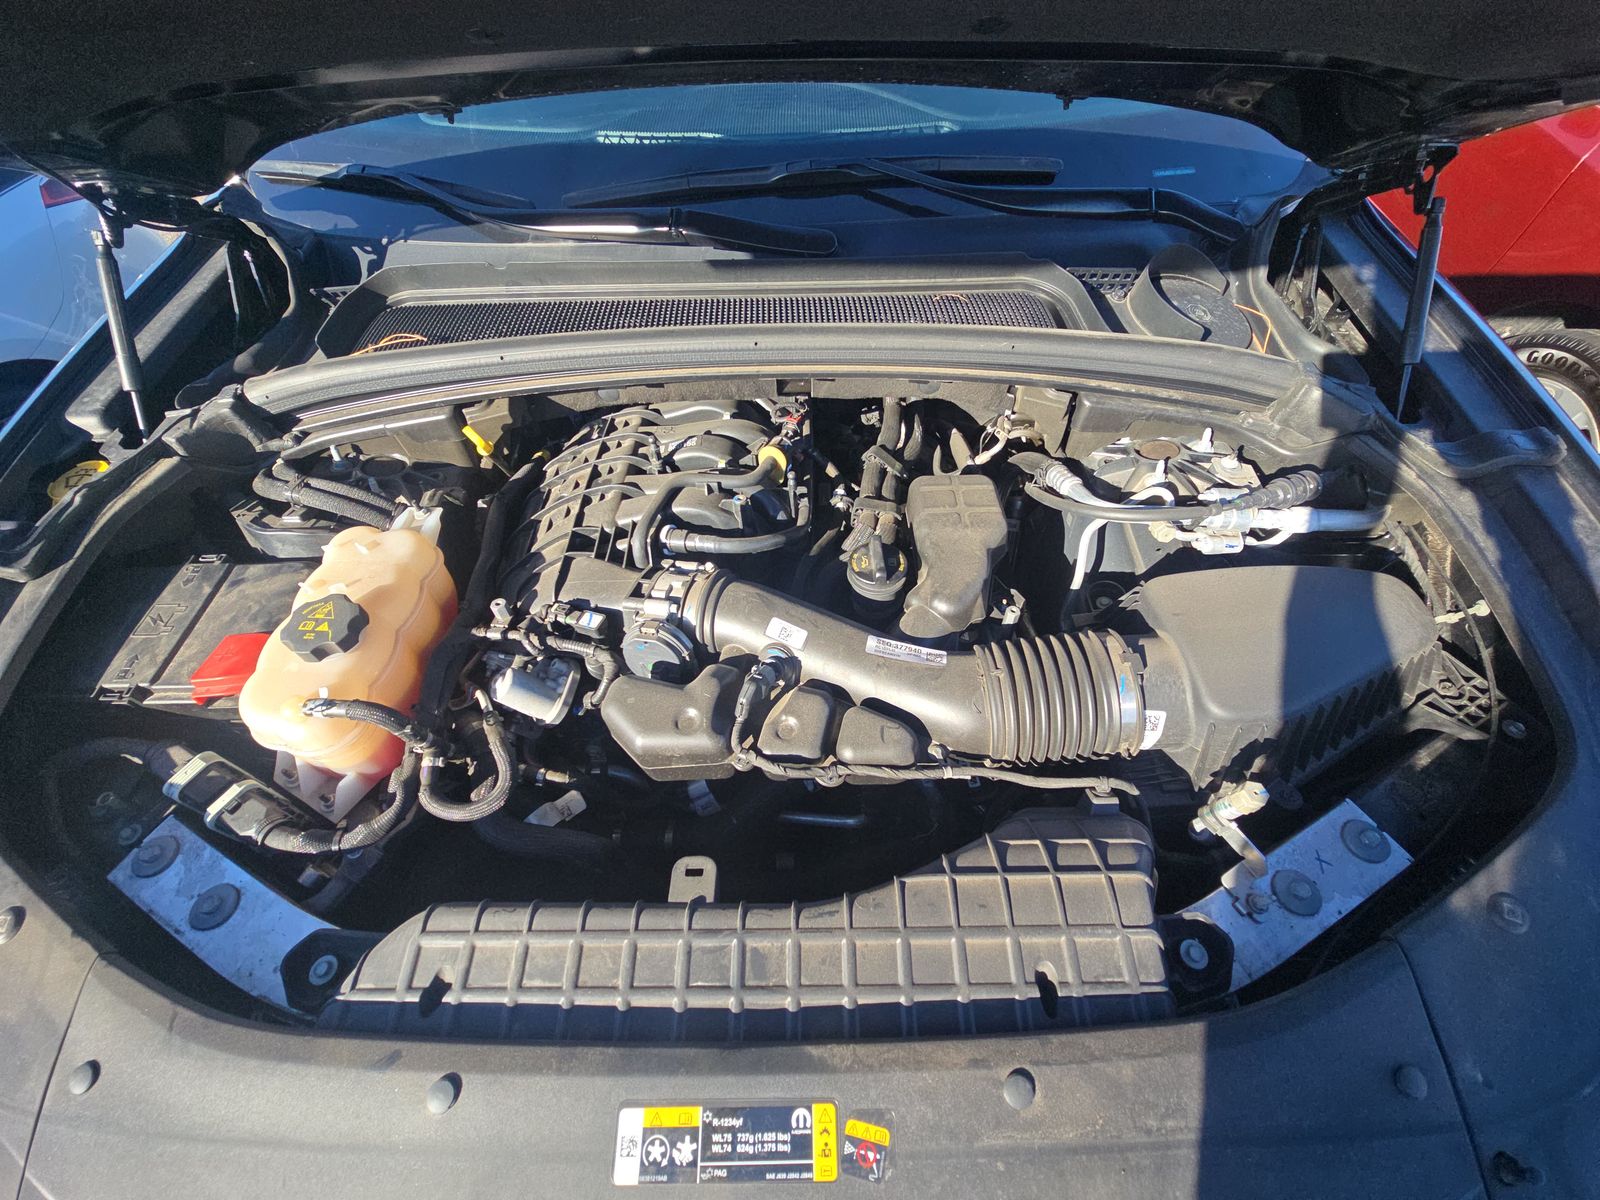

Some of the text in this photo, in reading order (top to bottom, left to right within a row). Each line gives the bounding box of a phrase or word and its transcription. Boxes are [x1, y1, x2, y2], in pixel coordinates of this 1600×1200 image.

[712, 1117, 744, 1128] R-1234yf
[712, 1133, 732, 1142] WL75
[737, 1133, 754, 1143] 737g
[777, 1132, 791, 1142] lbs)
[711, 1144, 732, 1153] WL74
[754, 1143, 776, 1154] (1.375
[777, 1142, 791, 1153] lbs)
[713, 1168, 728, 1178] PAG
